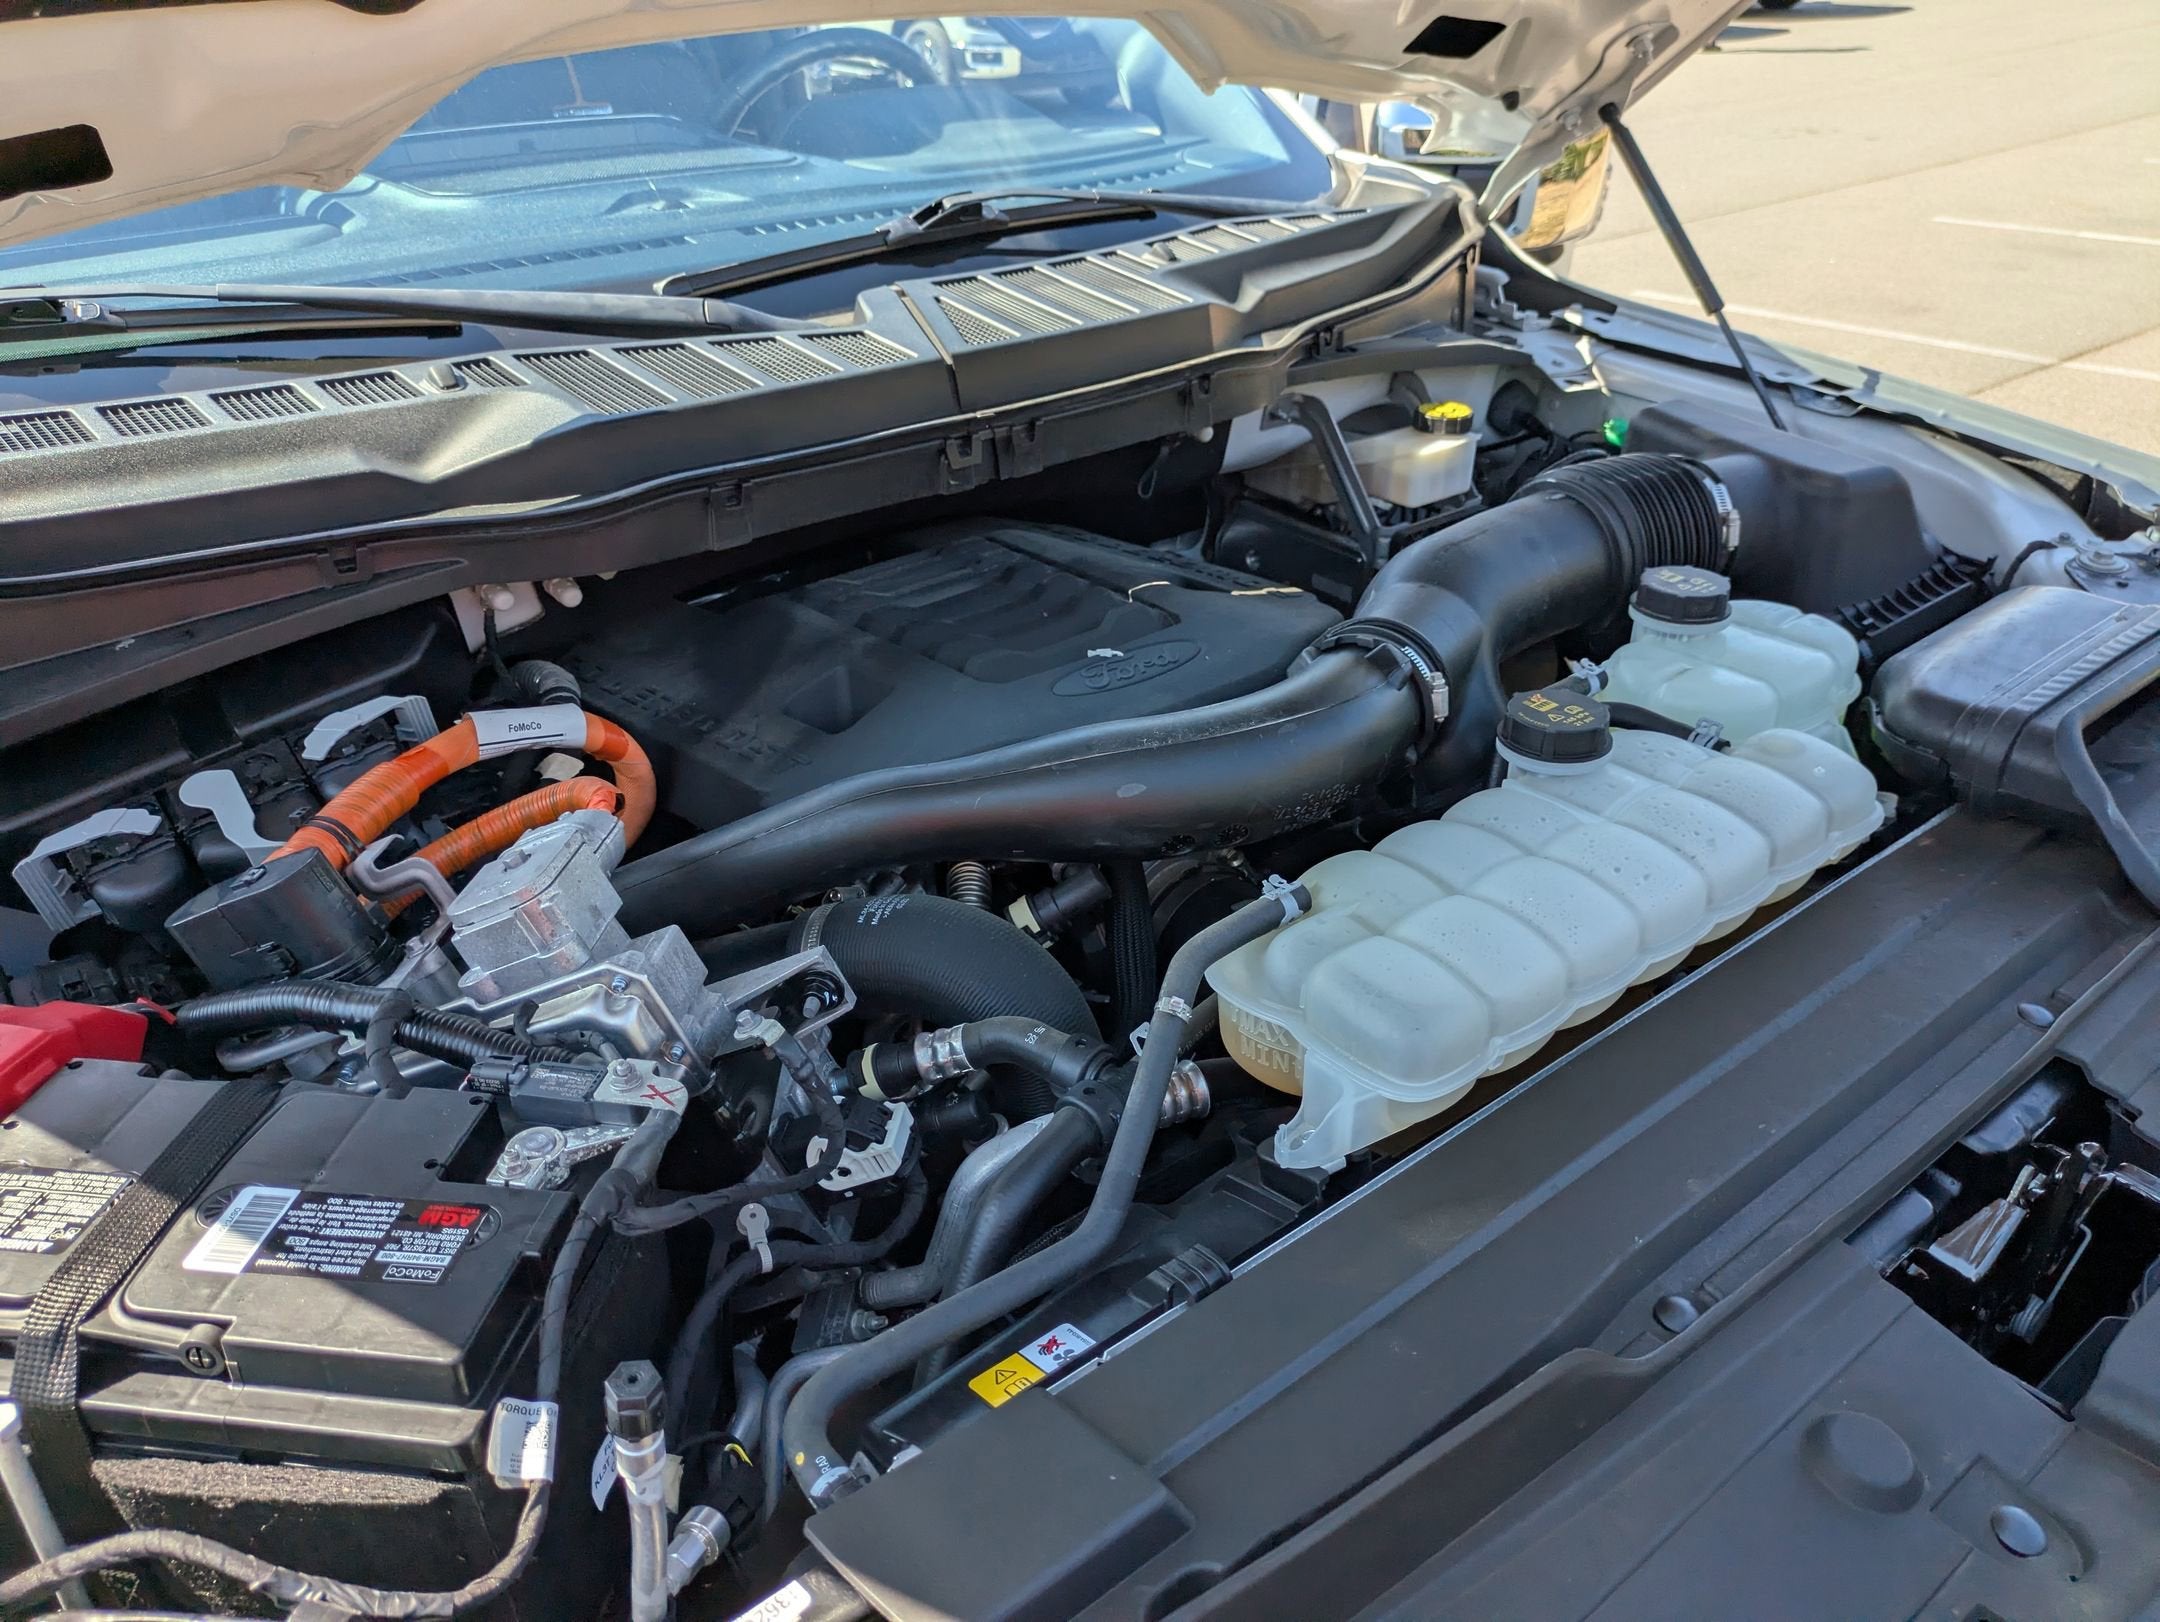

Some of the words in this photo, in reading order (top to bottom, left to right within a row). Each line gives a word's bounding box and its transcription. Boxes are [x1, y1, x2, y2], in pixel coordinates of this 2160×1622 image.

[1080, 649, 1179, 689] Ford
[508, 721, 542, 733] FoMoCo
[1239, 1011, 1289, 1047] MAX
[1240, 1035, 1290, 1073] MIN
[417, 1210, 479, 1229] AGM
[318, 1227, 386, 1238] AVERTISSEMENT
[308, 1238, 329, 1247] amps
[329, 1240, 360, 1249] cranking
[360, 1243, 377, 1251] Cold
[413, 1239, 441, 1247] MOTOR
[316, 1263, 361, 1275] WARNING:
[389, 1267, 441, 1279] FoMoCo
[501, 1402, 543, 1416] TORQUE
